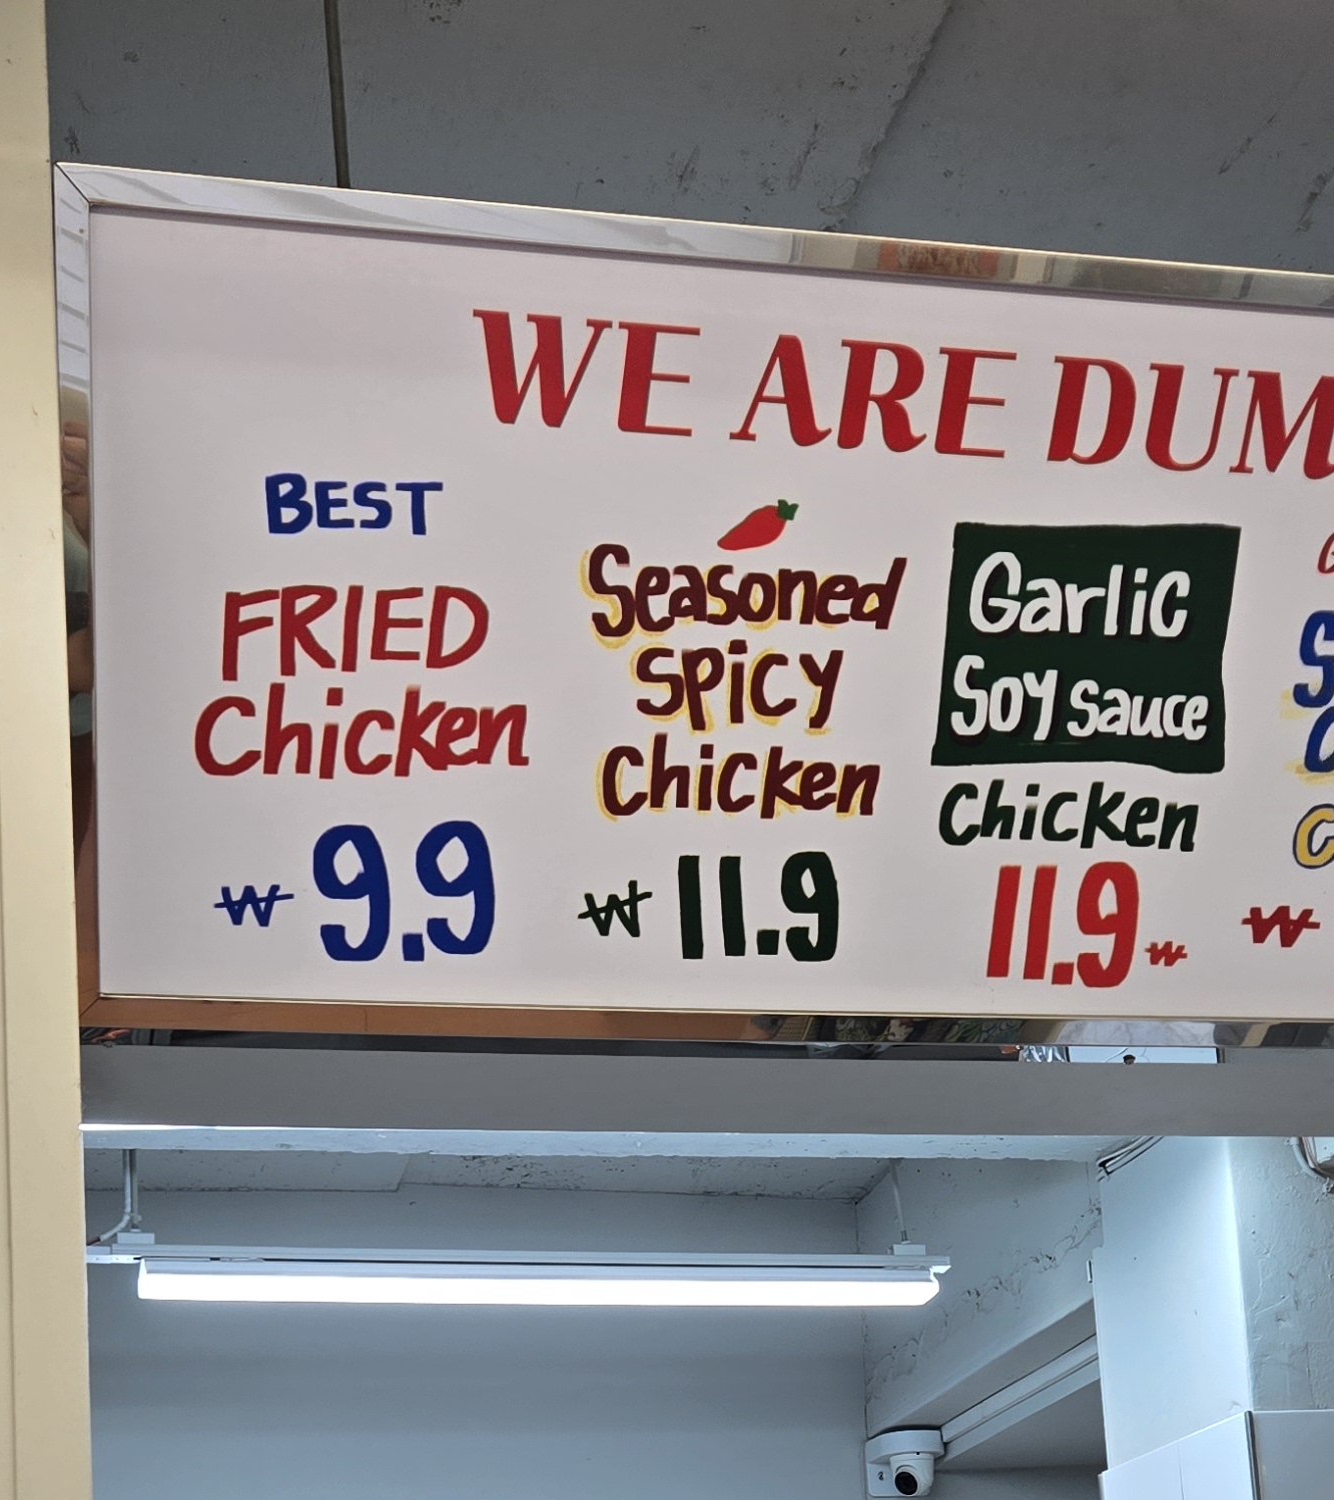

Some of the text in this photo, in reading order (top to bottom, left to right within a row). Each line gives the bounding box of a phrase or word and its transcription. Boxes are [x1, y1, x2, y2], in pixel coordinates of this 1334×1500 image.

[472, 308, 701, 437] WE
[729, 333, 1018, 459] ARE
[265, 473, 443, 536] BEST
[221, 584, 490, 682] FRIED
[587, 543, 909, 638] Seasoned
[969, 550, 1191, 638] Garlic
[194, 683, 530, 779] Chicken
[600, 733, 881, 820] Chicken
[937, 778, 1200, 852] Chicken
